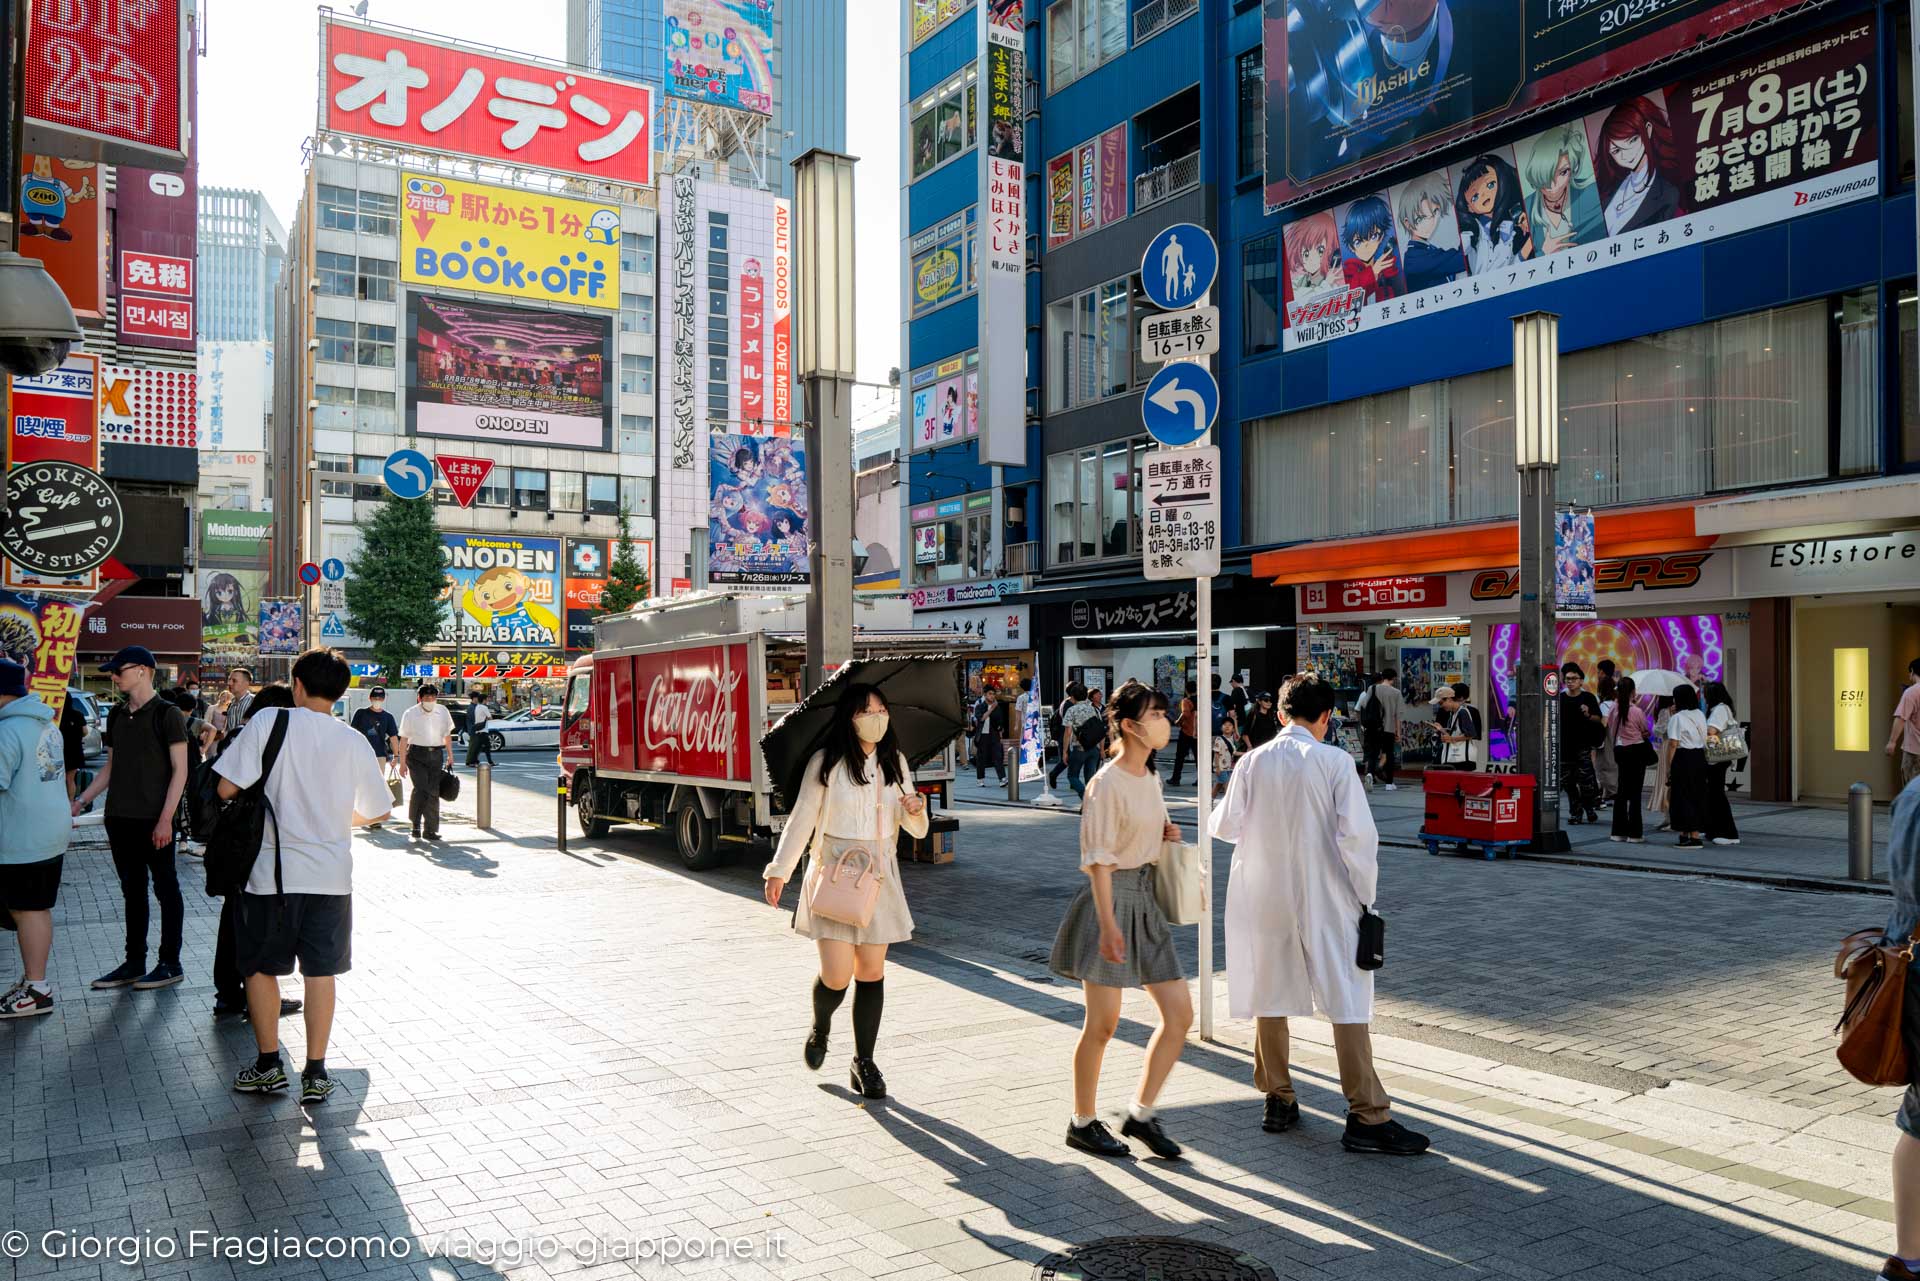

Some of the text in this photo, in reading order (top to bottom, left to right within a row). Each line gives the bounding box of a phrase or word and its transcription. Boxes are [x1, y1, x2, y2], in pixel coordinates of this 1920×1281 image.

[1600, 0, 1677, 34] 2024.
[686, 64, 727, 81] LOVE
[993, 48, 1011, 120] 小豆柴の郷
[674, 76, 727, 94] merci
[334, 49, 644, 161] オノデン
[1692, 63, 1868, 143] 7月8日(土)
[1695, 99, 1861, 174] あさ8時から
[1051, 162, 1073, 233] 麻雀
[1809, 176, 1876, 203] BUSHIROAD
[406, 194, 451, 215] 万世橋
[460, 192, 583, 238] 駅から1分
[1008, 164, 1020, 255] 和風耳かき
[776, 205, 788, 309] ADULT GOODS
[128, 259, 187, 289] 免税
[1380, 223, 1716, 321] 答えはいつも、ファイトの中にある。
[126, 305, 188, 330] 면세점
[1148, 315, 1212, 338] 自転車を除く
[1154, 334, 1205, 357] 16-19
[776, 333, 788, 421] LOVE MERCI
[915, 394, 926, 418] 2F
[100, 420, 133, 435] tore
[475, 414, 548, 434] ONODEN
[924, 417, 936, 440] 3F
[447, 462, 483, 476] 止まれ
[1148, 458, 1213, 477] 自転車を除く
[6, 467, 112, 508] SMOKER'S
[453, 475, 478, 487] STOP
[1149, 474, 1212, 491] 一方通行
[36, 488, 81, 510] Cafe
[1150, 508, 1192, 523] 日曜の
[207, 523, 268, 538] Melonbook
[4, 528, 110, 568] VAPE STAND
[466, 538, 523, 549] Welcome to
[715, 543, 799, 557] ワールドダイスター
[1151, 554, 1184, 568] を除く
[1470, 552, 1714, 601] GAERS
[528, 578, 554, 604] 迎
[956, 584, 996, 601] maidreamin
[1309, 590, 1324, 602] B1
[89, 617, 107, 634] 福
[121, 622, 145, 630] CHOW
[147, 622, 160, 630] TAI
[1007, 616, 1019, 627] 24
[1384, 624, 1472, 640] GAMERS
[32, 604, 82, 715] 初代
[1840, 690, 1864, 701] ES!!
[644, 668, 741, 752] Coca-Cola
